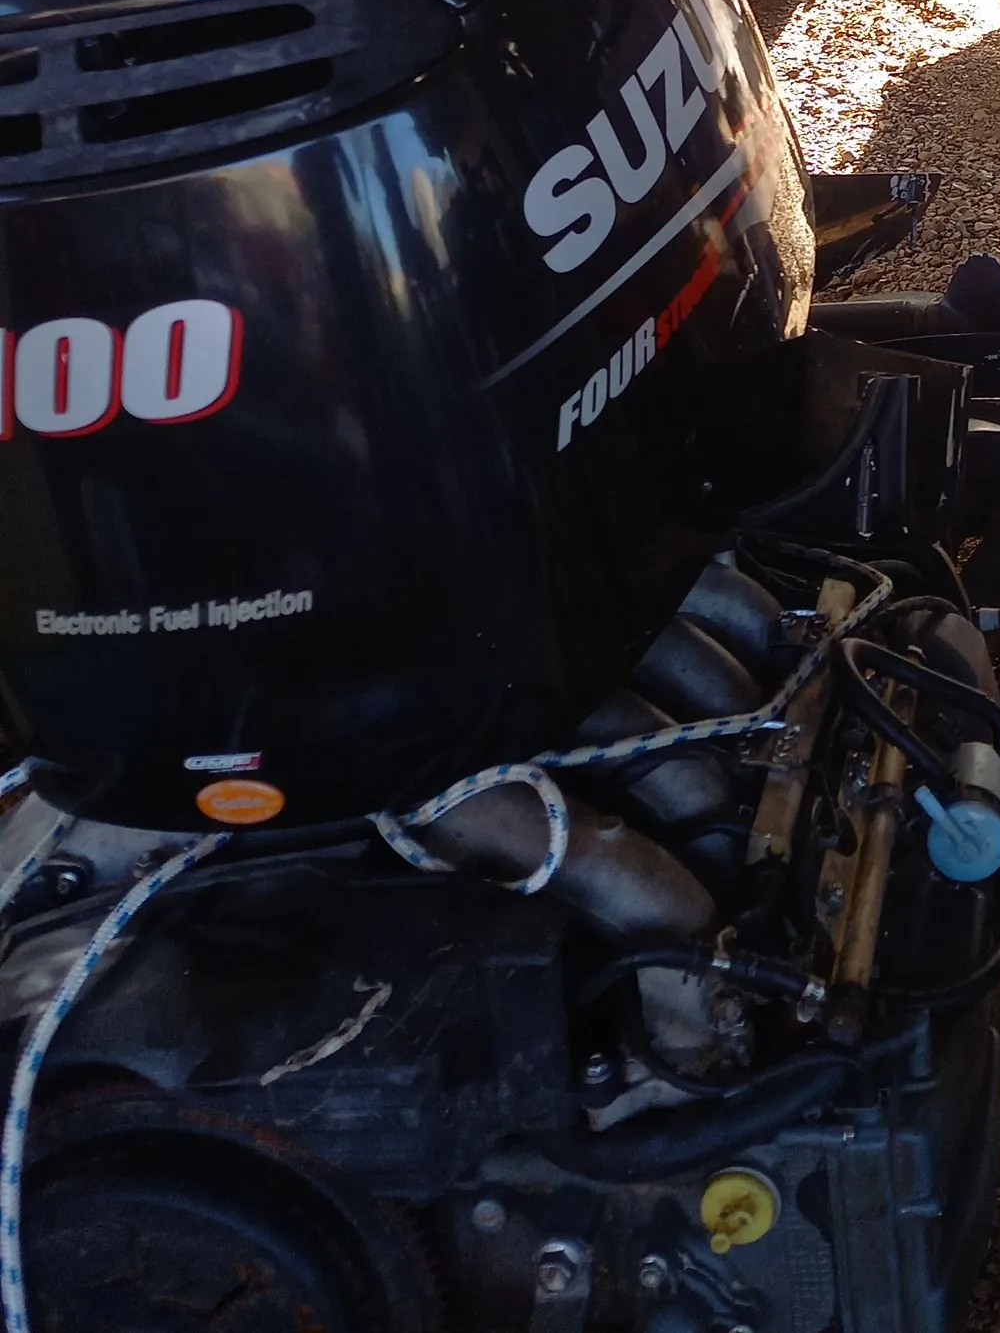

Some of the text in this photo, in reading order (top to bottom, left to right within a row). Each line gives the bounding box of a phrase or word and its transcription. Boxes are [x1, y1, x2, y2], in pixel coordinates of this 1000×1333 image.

[0, 298, 244, 441] 00
[35, 588, 313, 636] Electronic Fuel Injection
